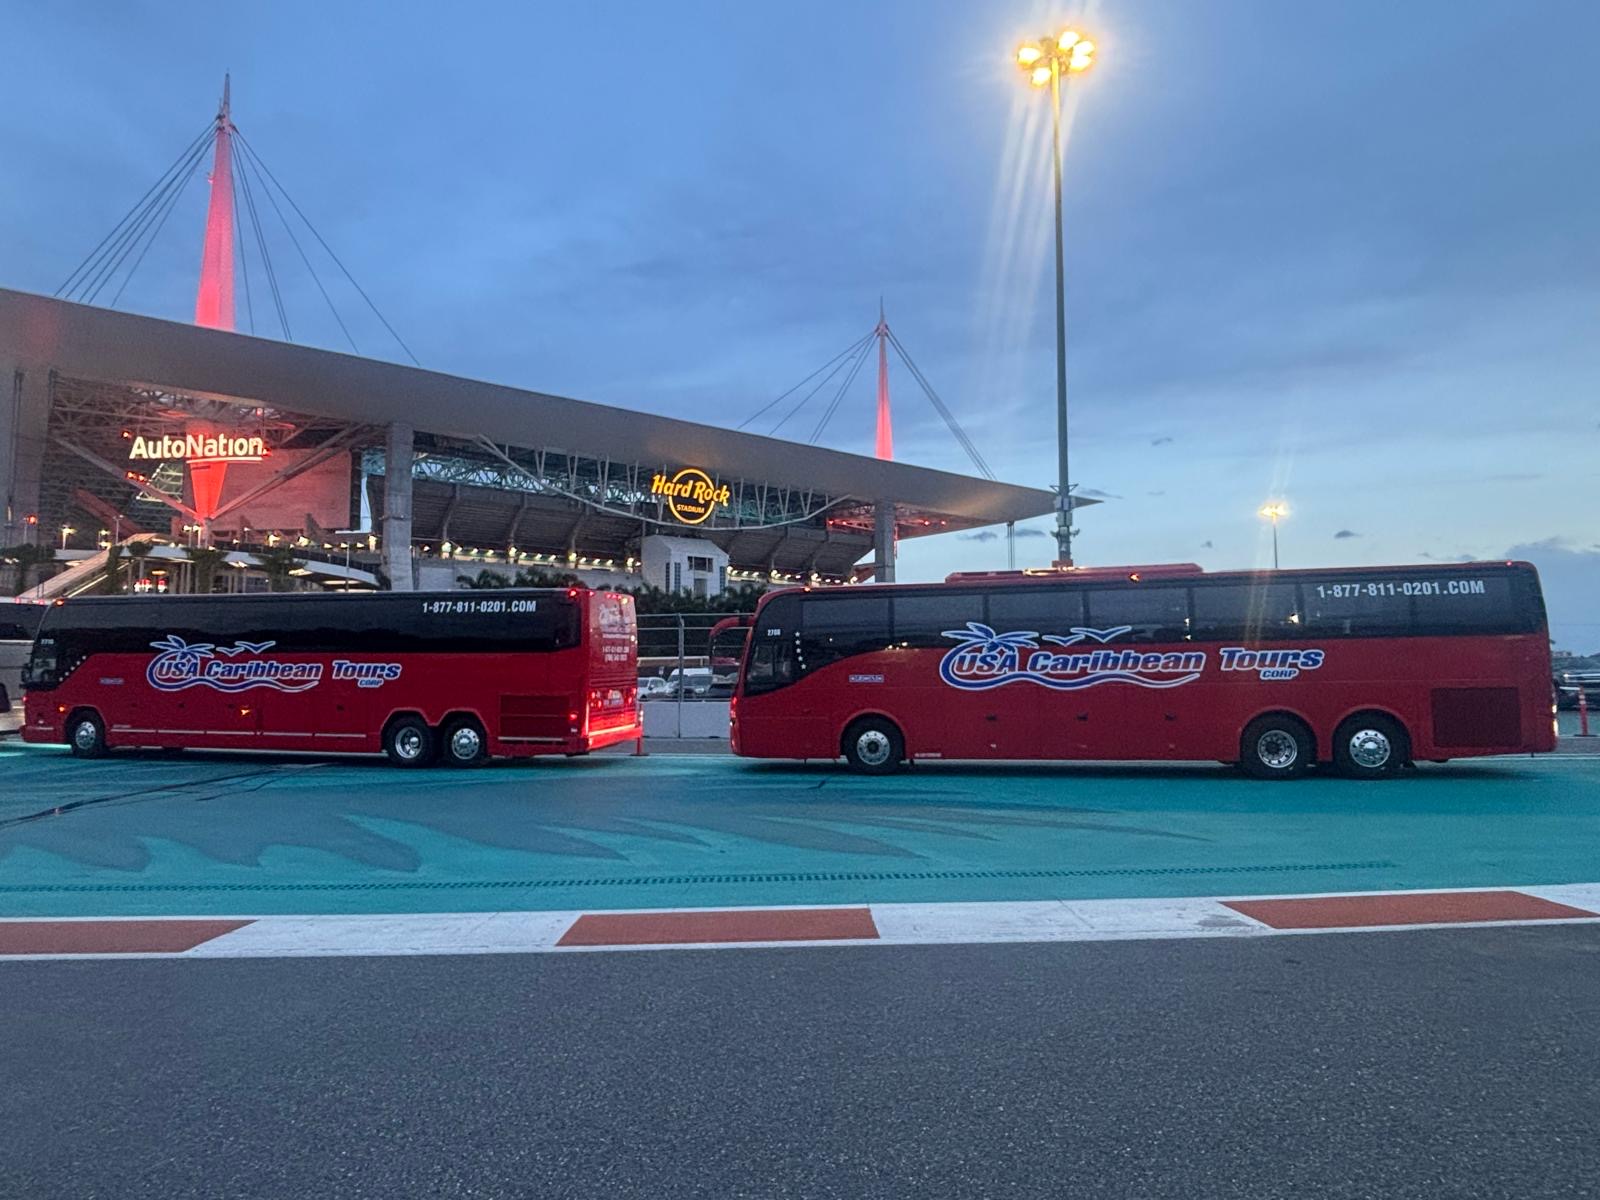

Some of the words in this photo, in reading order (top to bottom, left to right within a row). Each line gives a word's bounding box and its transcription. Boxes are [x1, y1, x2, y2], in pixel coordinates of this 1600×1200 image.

[129, 433, 264, 459] AutoNation
[651, 474, 694, 498] Hard
[693, 481, 730, 507] Rock
[676, 504, 705, 514] STADIUM
[1316, 580, 1486, 599] 1-877-811-0201.COM
[422, 600, 537, 613] 1-877-811-0201.COM
[155, 660, 199, 680] USA
[205, 661, 323, 680] Caribbean
[332, 660, 402, 680] Tours
[953, 652, 1018, 675] USA
[1027, 651, 1206, 673] Caribbean
[1219, 647, 1324, 671] Tours
[1260, 668, 1299, 680] CORP
